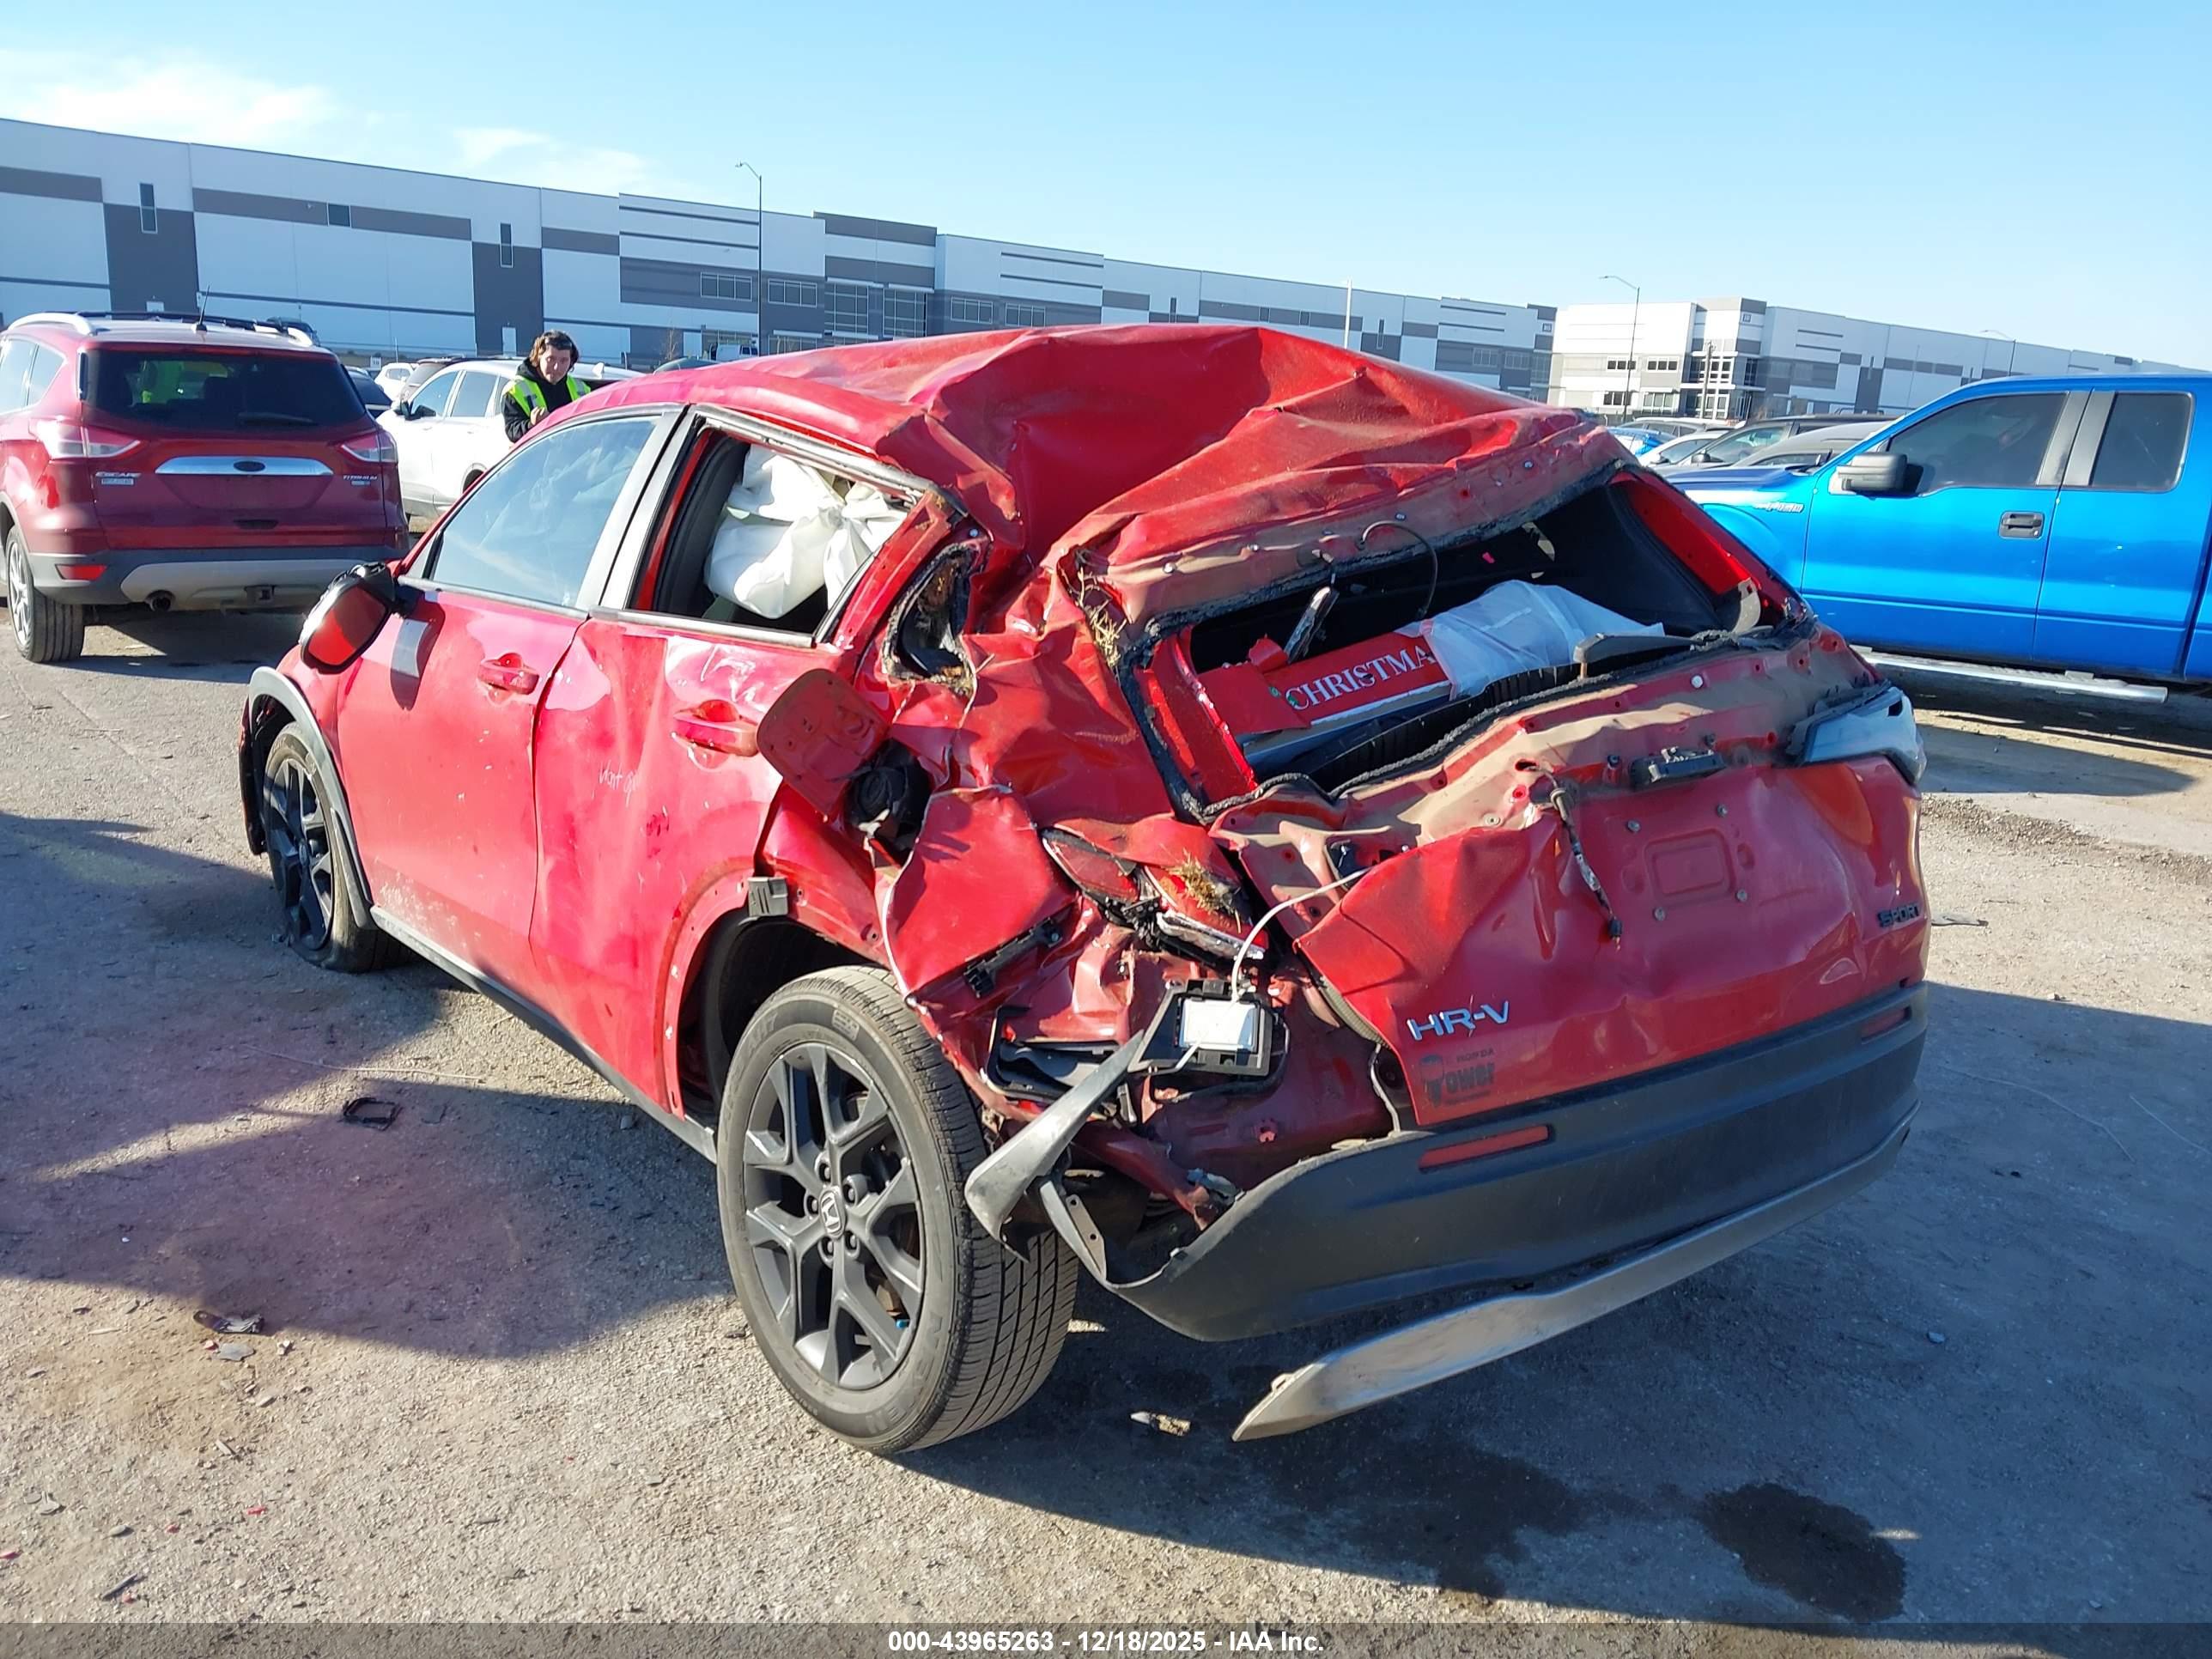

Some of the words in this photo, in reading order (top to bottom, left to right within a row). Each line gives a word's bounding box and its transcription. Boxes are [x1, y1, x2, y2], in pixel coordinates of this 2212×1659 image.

[1285, 645, 1437, 710] CHRISTMA
[1877, 902, 1919, 927] SPORT
[1407, 1000, 1509, 1041] HR-V
